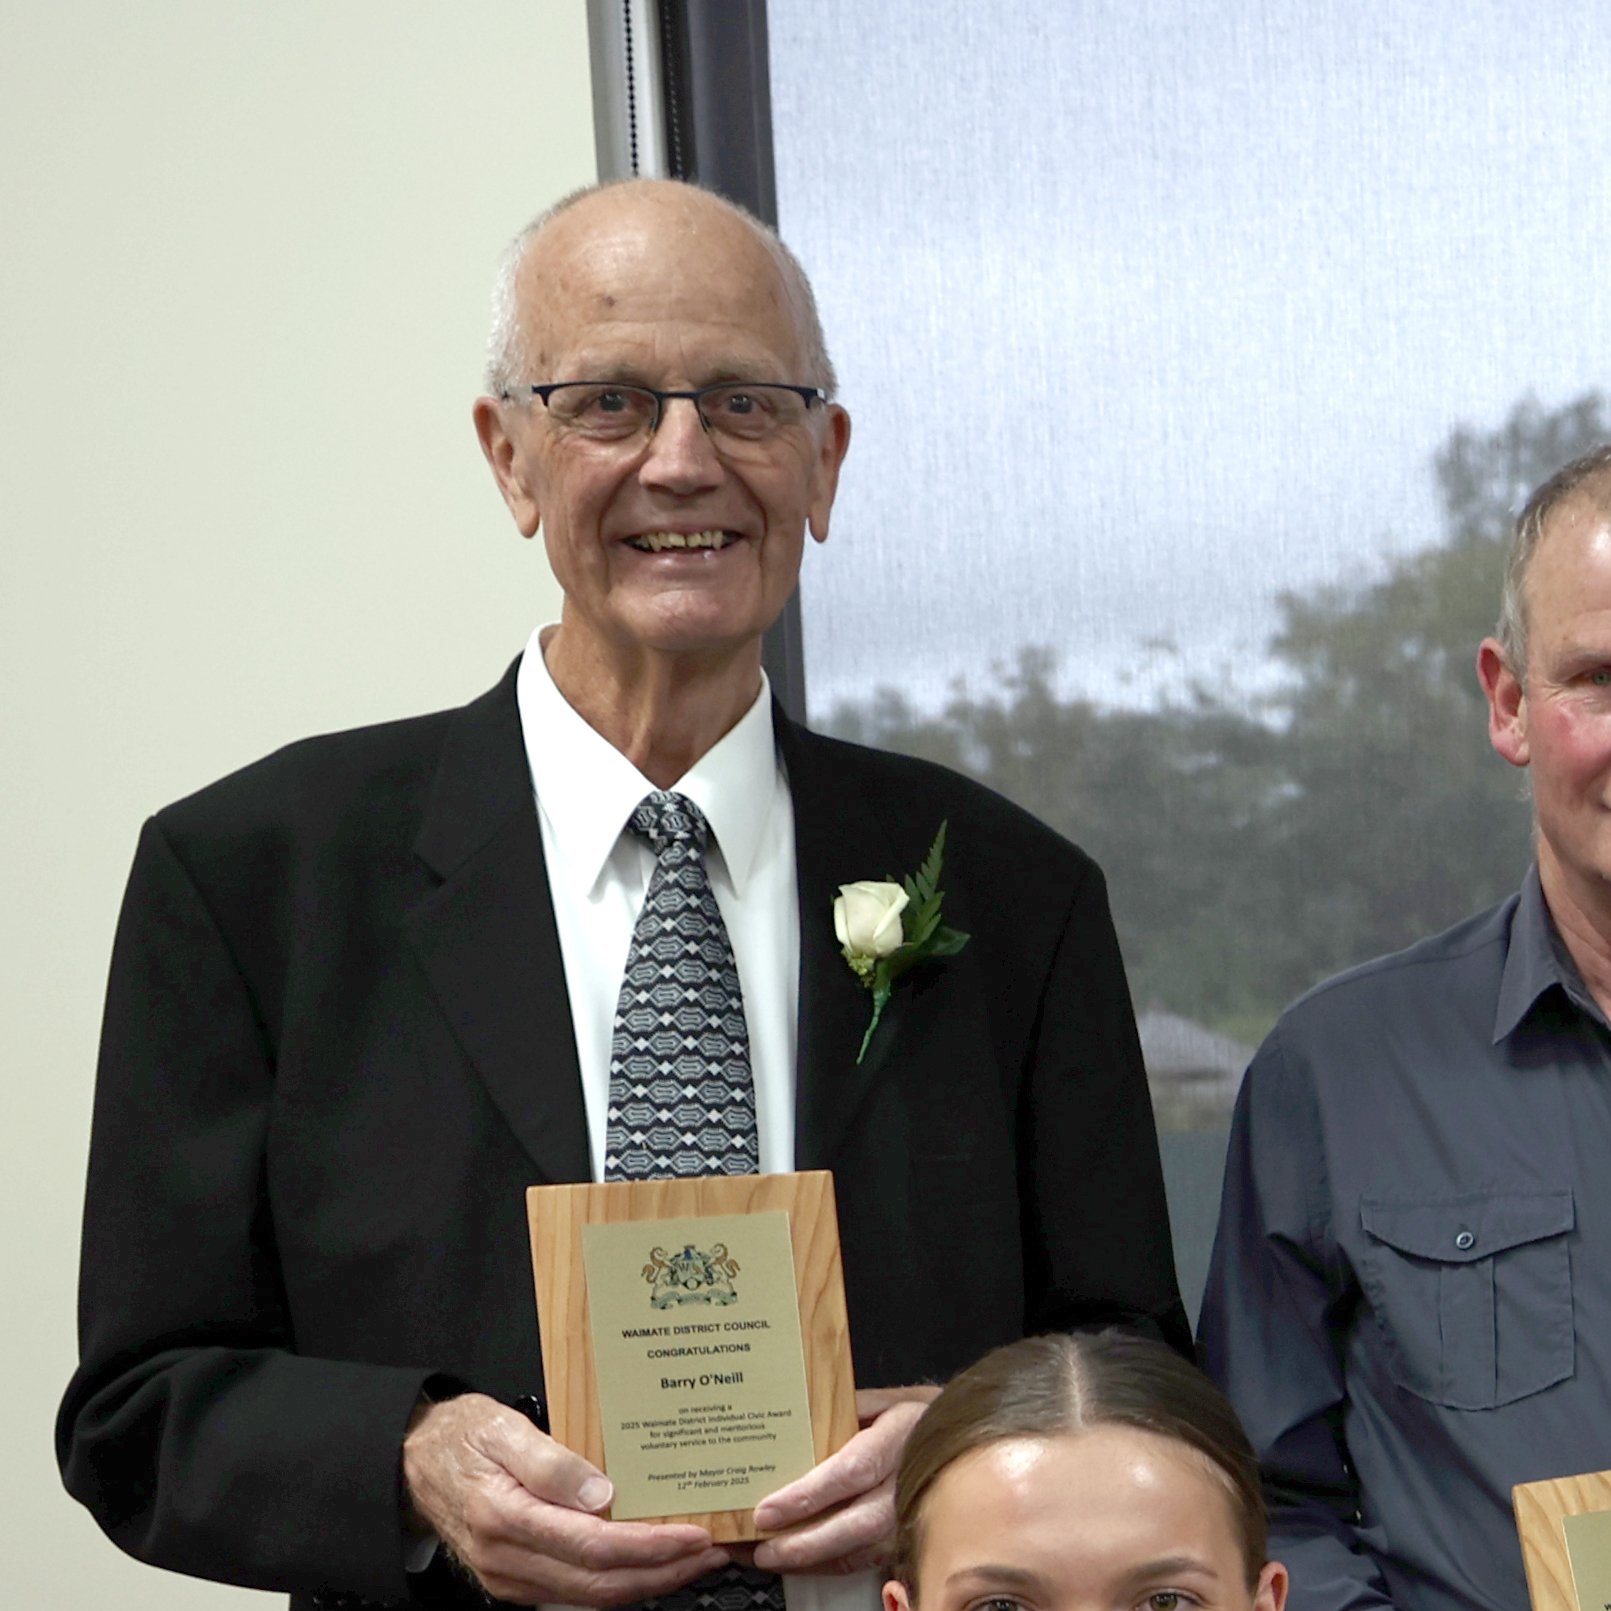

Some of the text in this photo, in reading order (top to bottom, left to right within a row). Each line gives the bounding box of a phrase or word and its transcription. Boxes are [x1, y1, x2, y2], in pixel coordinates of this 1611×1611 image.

[621, 1320, 770, 1338] WAIMATE DISTRICT COUNCIL
[647, 1343, 751, 1359] CONGRATULATIONS
[660, 1372, 744, 1389] Barry O'Neill
